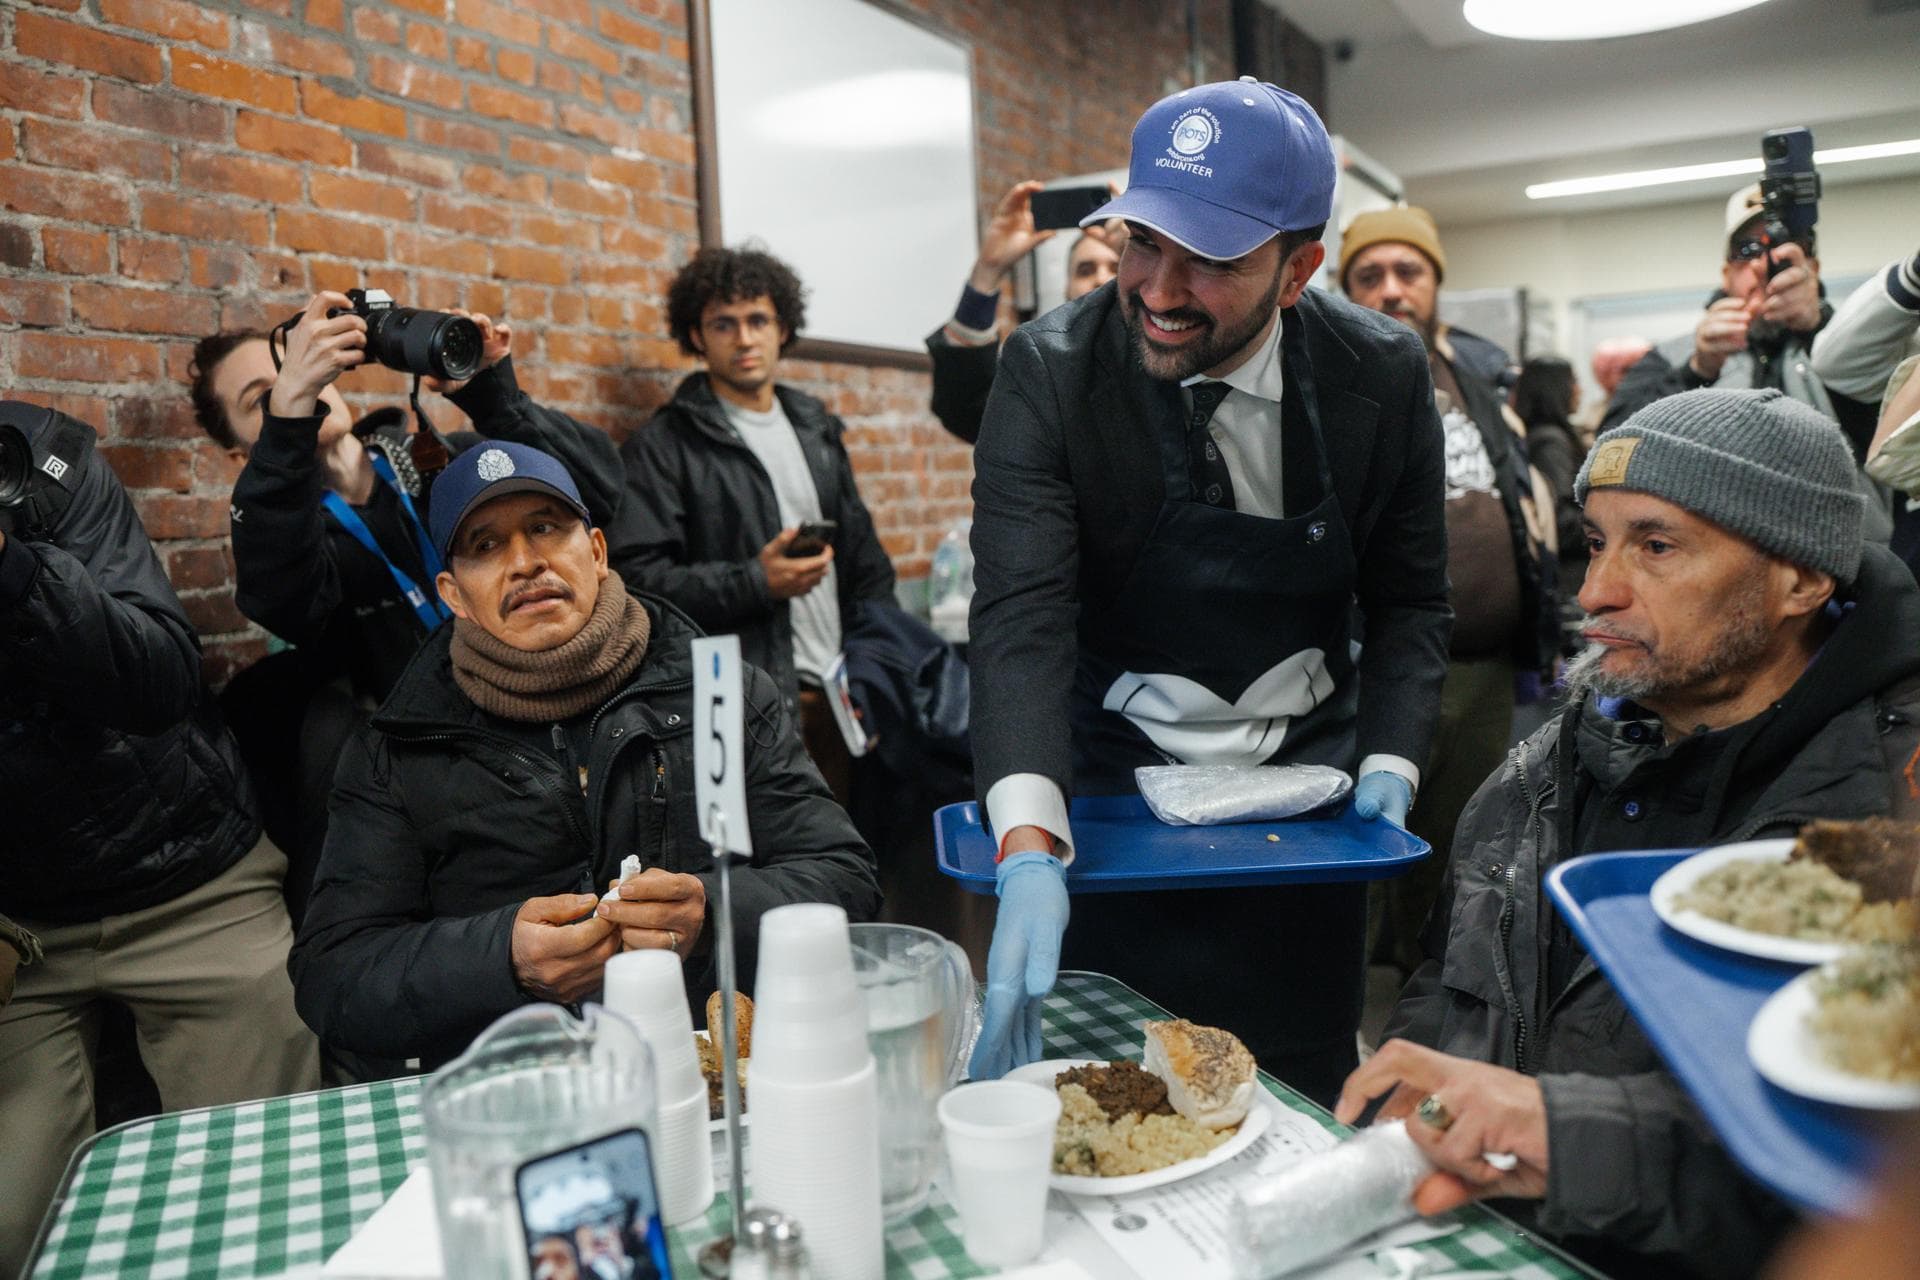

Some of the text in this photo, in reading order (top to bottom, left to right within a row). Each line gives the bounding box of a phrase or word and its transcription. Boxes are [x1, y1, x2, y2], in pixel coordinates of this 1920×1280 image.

[1171, 120, 1179, 130] am
[1179, 109, 1192, 121] part
[1201, 107, 1212, 117] the
[1210, 115, 1223, 144] solution
[1178, 127, 1206, 142] POTS
[1155, 158, 1213, 178] VOLUNTEER
